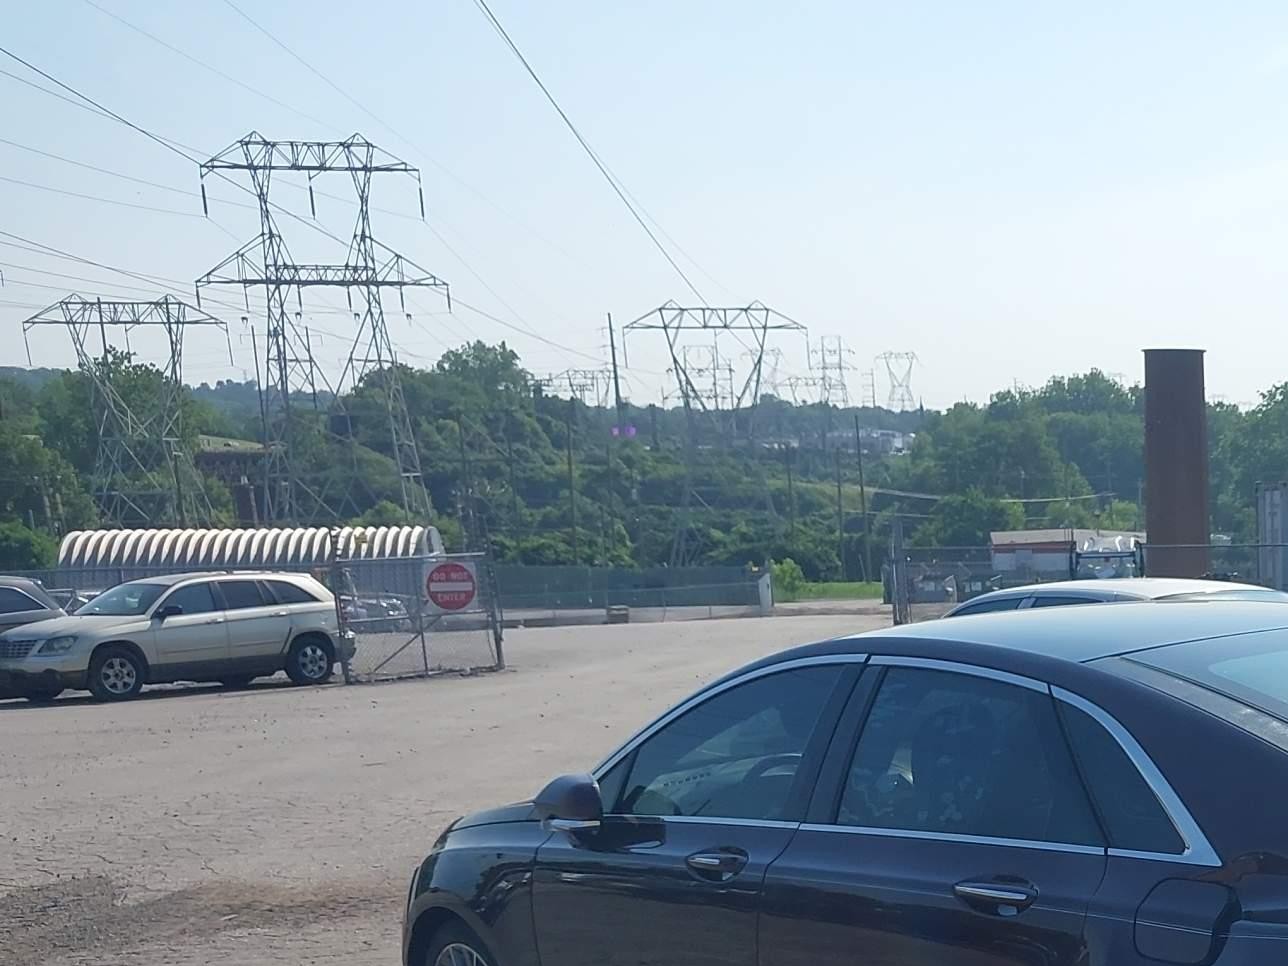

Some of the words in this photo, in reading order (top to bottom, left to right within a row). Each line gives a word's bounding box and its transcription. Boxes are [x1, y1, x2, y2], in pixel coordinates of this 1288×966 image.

[431, 571, 446, 581] DO
[450, 571, 469, 581] NOT
[438, 592, 466, 602] ENTER
